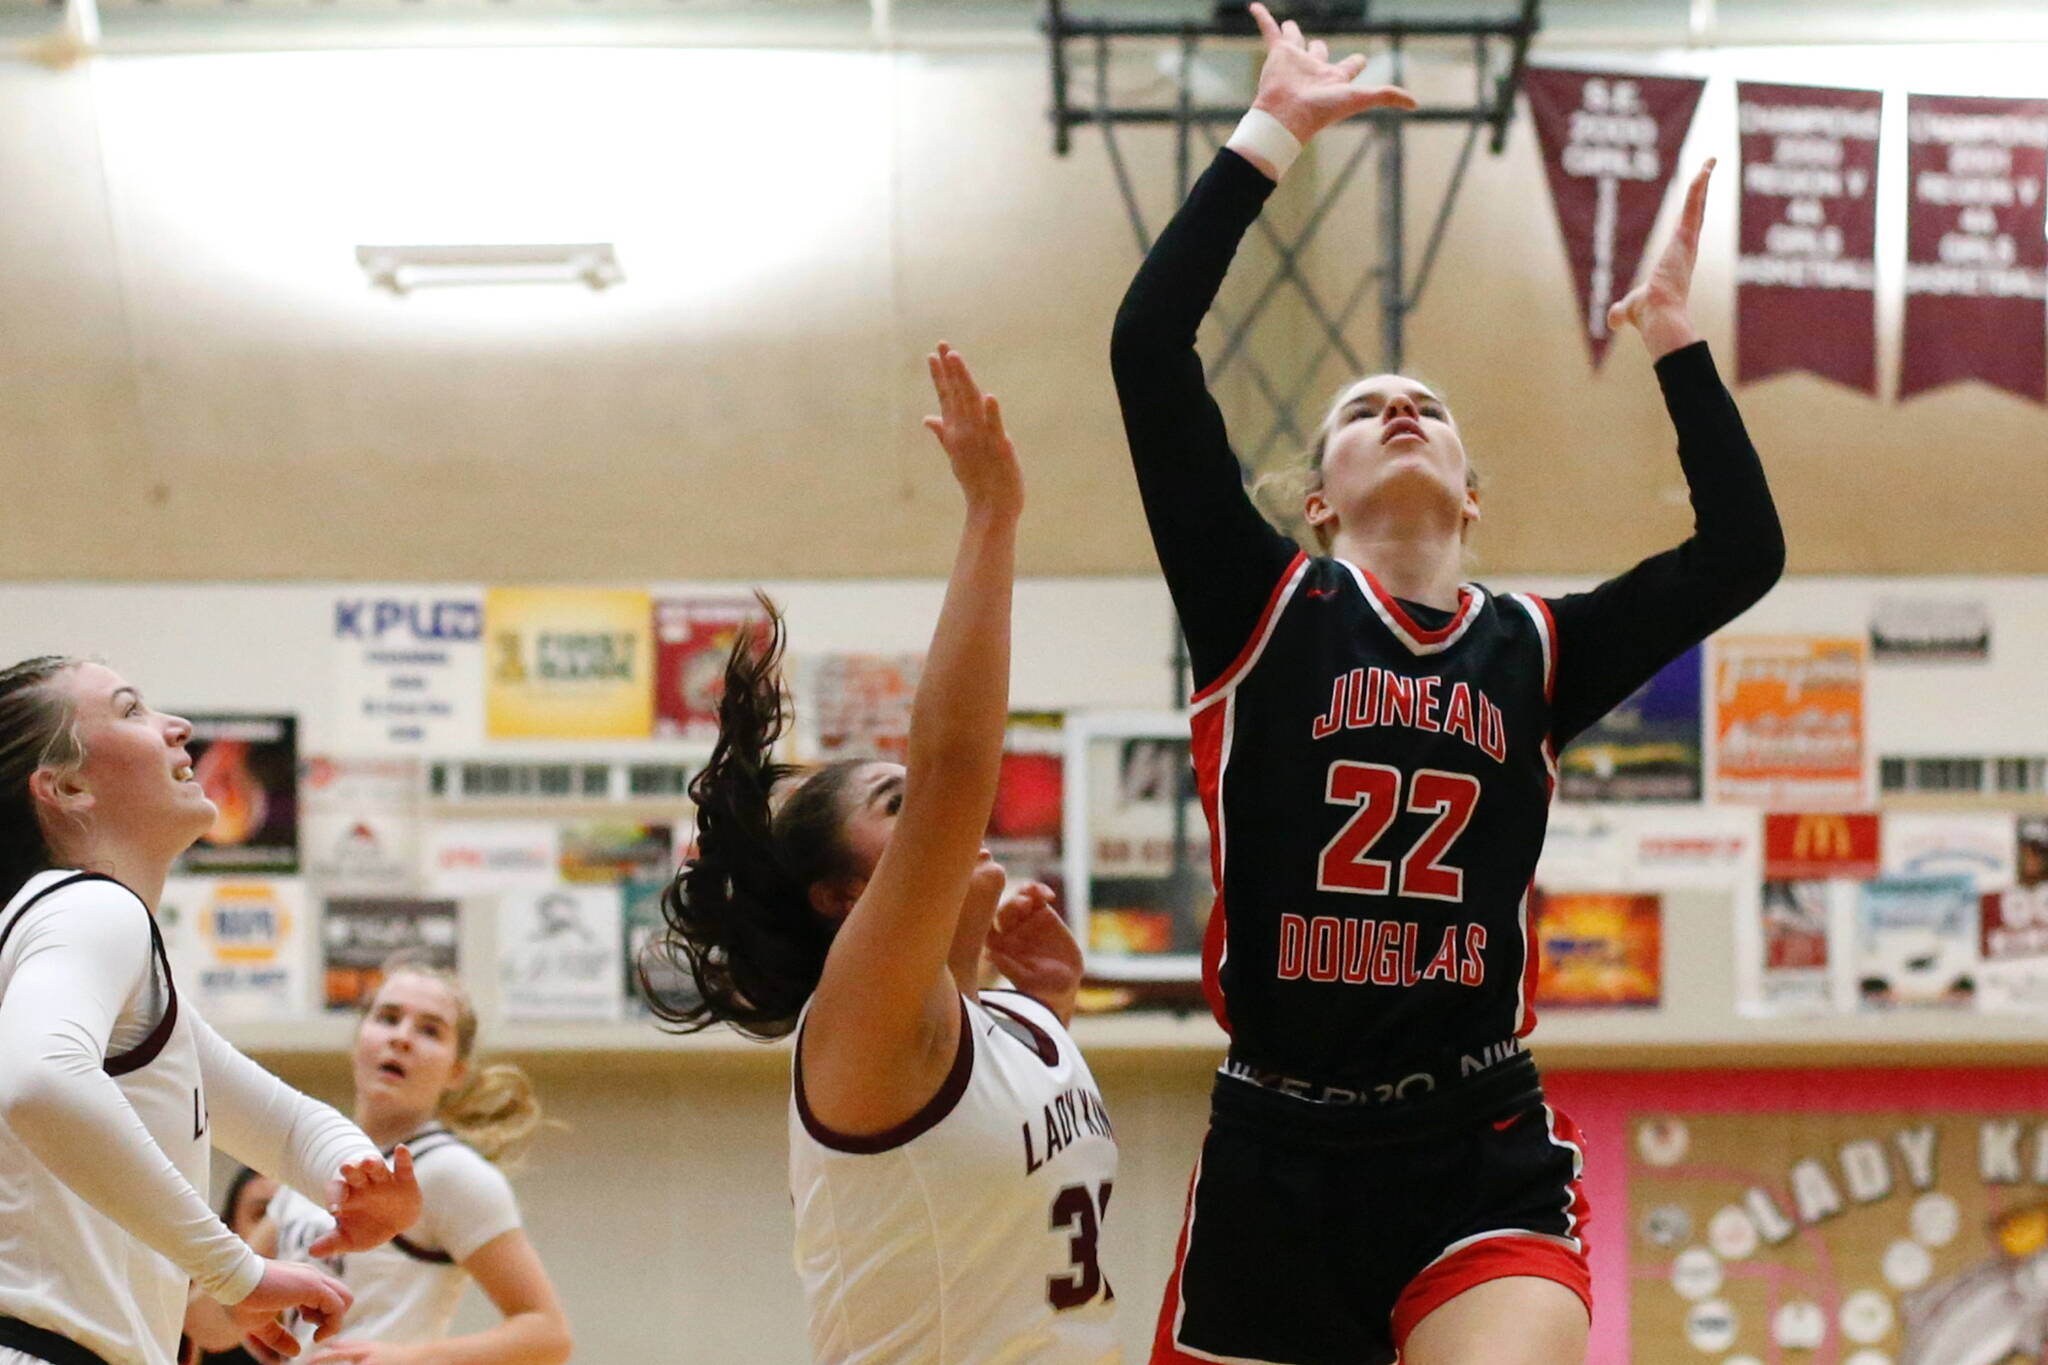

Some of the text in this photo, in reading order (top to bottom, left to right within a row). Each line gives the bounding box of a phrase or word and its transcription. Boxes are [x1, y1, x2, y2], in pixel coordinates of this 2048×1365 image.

[1312, 667, 1507, 764] JUNEAU
[1316, 759, 1481, 902] 22
[1277, 912, 1487, 987] DOUGLAS
[1022, 1089, 1081, 1175] LADY
[1744, 1123, 1937, 1243] LADY
